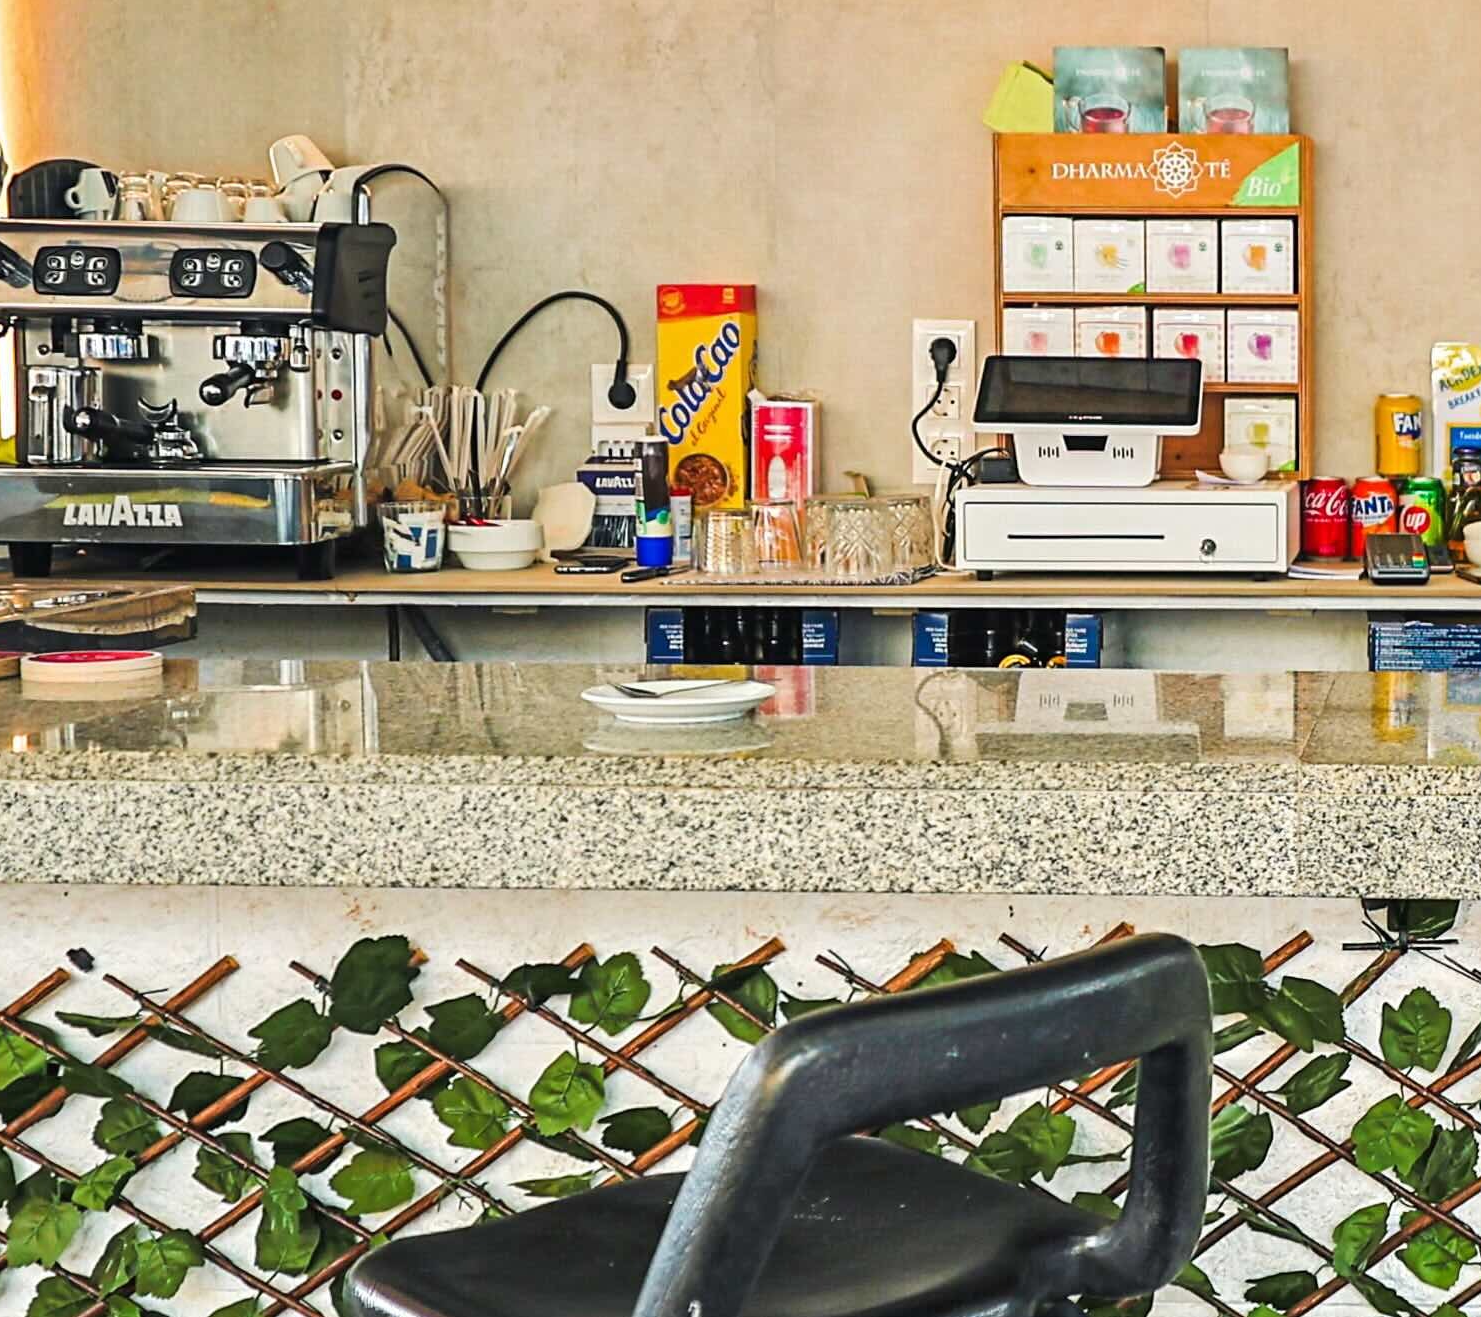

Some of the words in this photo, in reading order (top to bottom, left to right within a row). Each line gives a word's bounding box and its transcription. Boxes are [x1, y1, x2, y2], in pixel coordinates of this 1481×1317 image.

[1051, 161, 1150, 180] DHARMA
[1246, 176, 1282, 198] Bio
[1393, 411, 1422, 434] FAN
[595, 476, 636, 489] LAVAZZ
[62, 494, 184, 528] LAVAZZA
